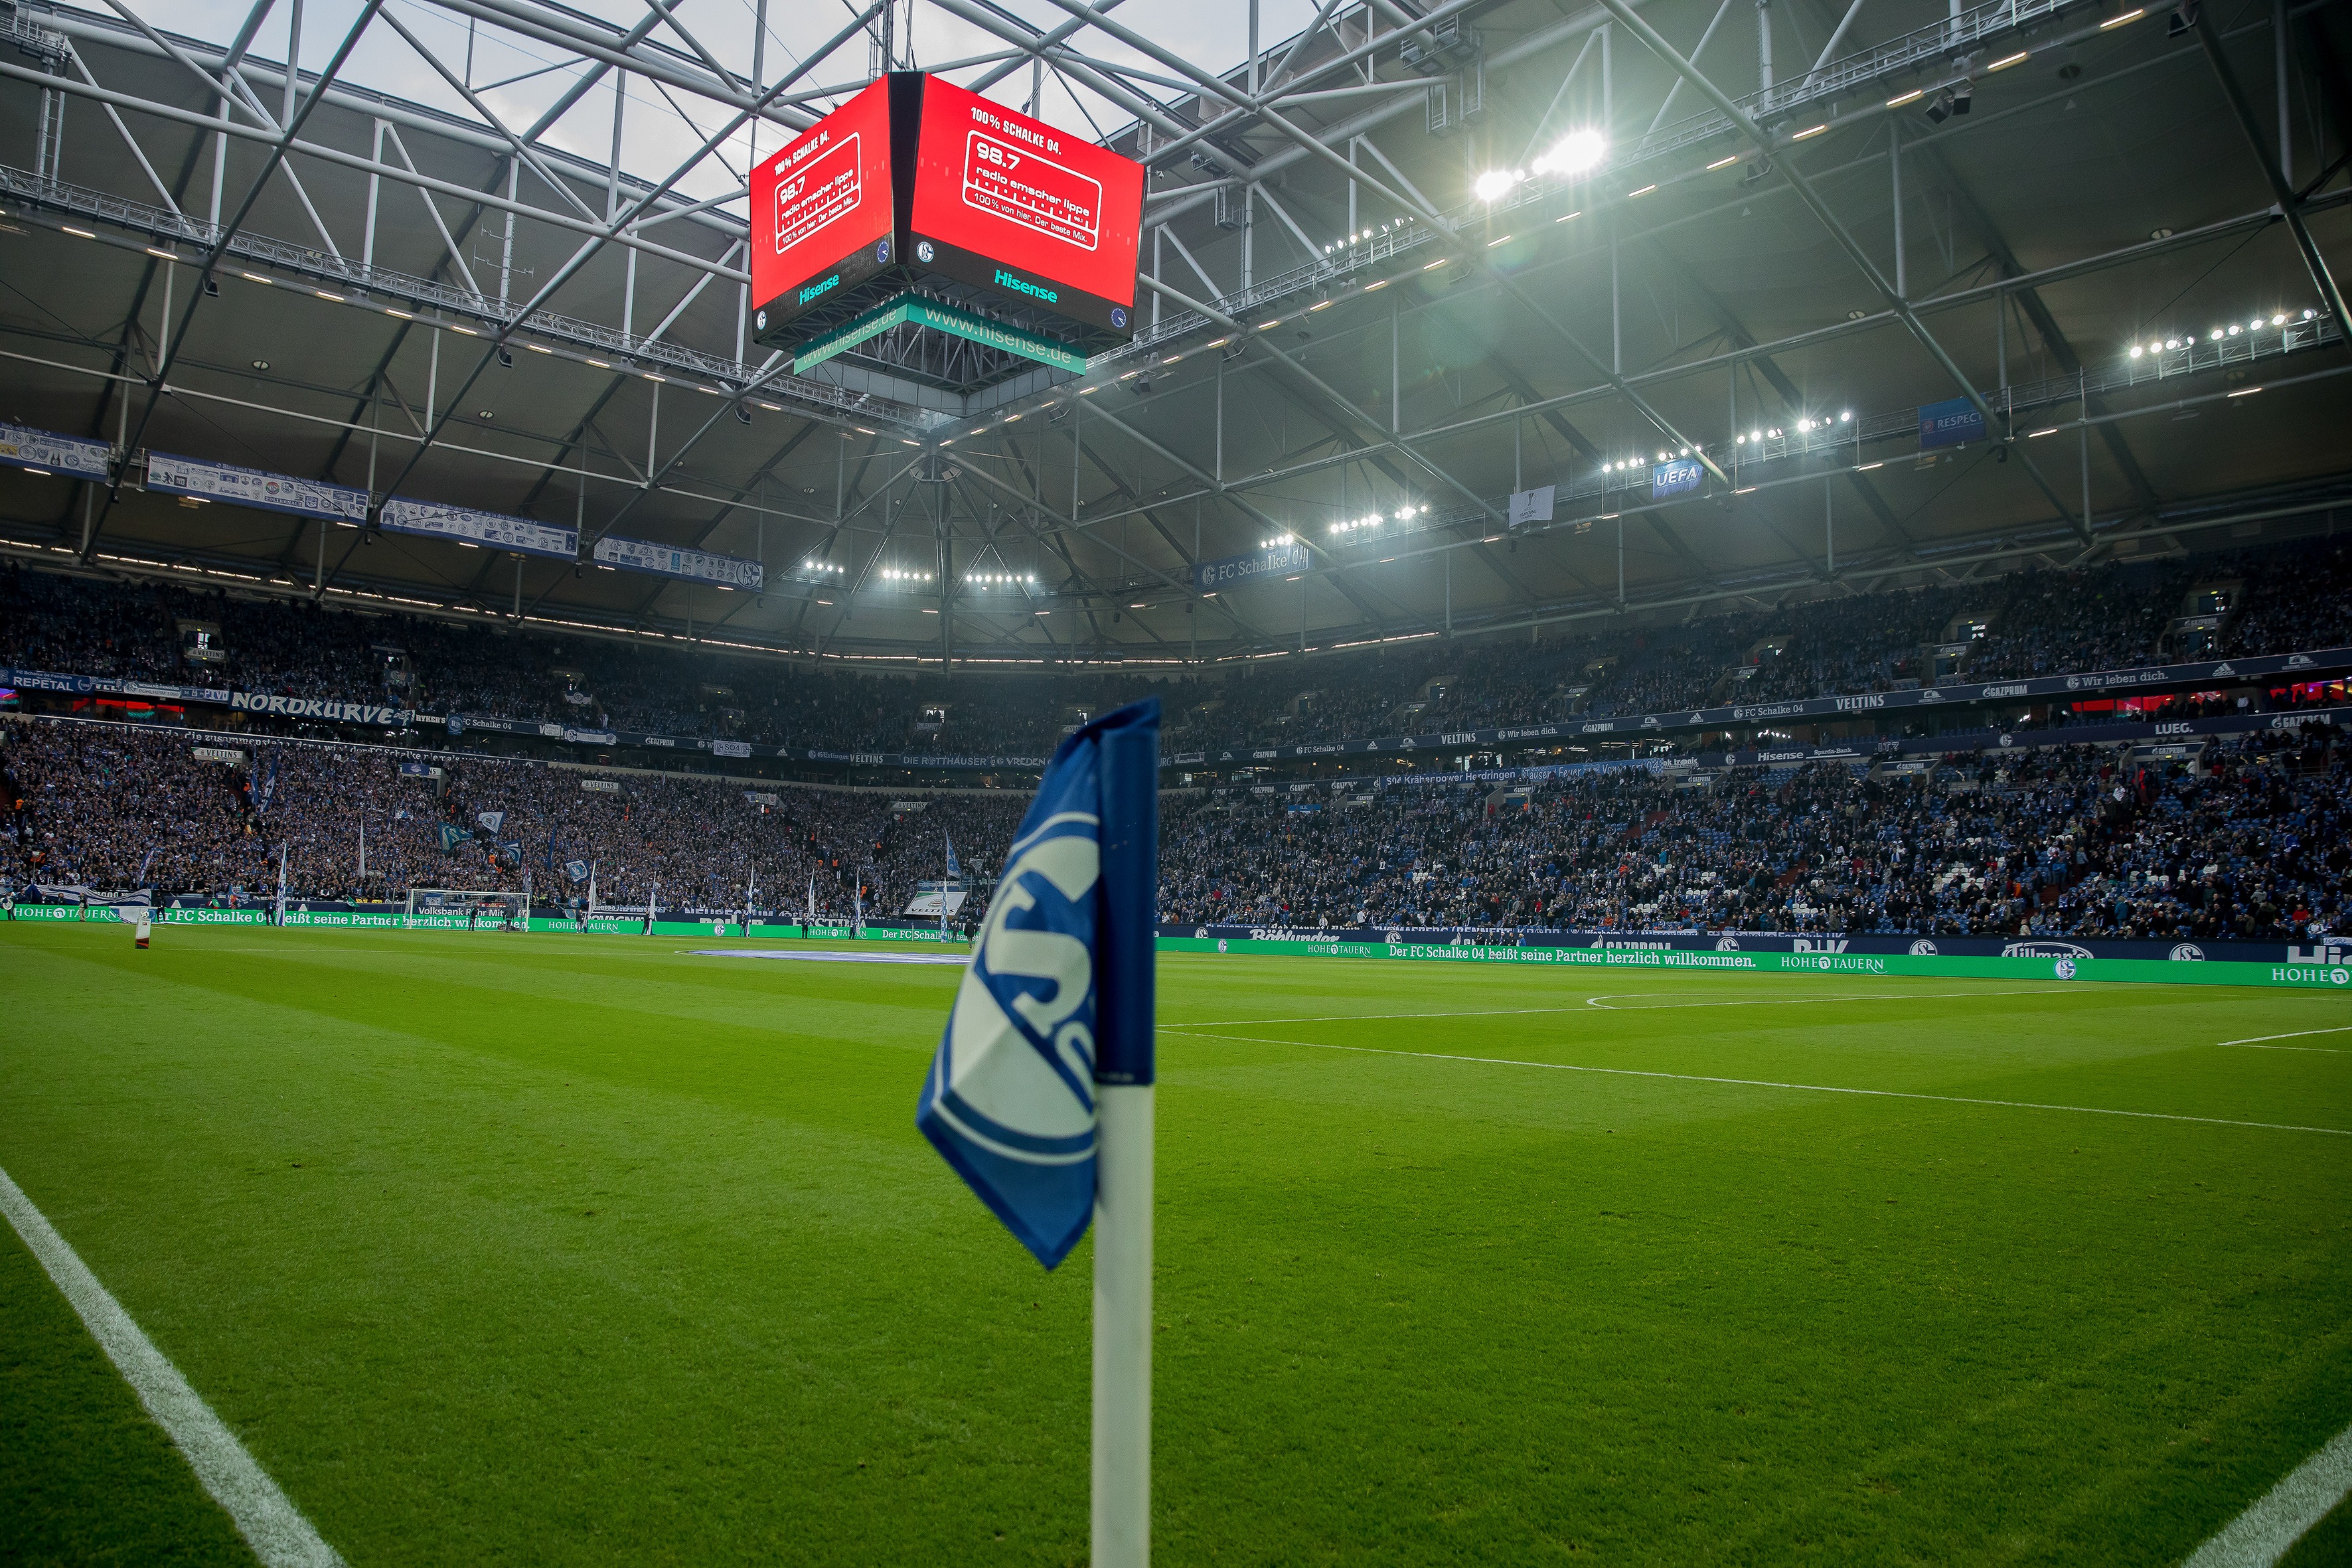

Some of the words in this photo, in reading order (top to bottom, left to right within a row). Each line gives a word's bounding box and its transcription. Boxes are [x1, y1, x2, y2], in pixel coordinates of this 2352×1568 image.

[971, 106, 1000, 130] 100%
[1003, 120, 1044, 148] SCHALKE
[1047, 139, 1062, 155] 04.
[774, 155, 792, 177] 100%
[792, 137, 819, 165] SCHALKE
[819, 129, 830, 146] 04.
[977, 141, 1020, 171] 98.7
[779, 175, 806, 205] 98.7
[781, 203, 801, 221] radio
[801, 181, 834, 208] emscher
[834, 168, 854, 187] lippe
[976, 167, 1008, 185] radio
[1010, 179, 1061, 205] emscher
[1063, 198, 1090, 217] lippe
[974, 193, 999, 209] 100%
[1000, 204, 1014, 215] von
[1016, 207, 1032, 222] hier.
[1034, 215, 1049, 228] Der
[1050, 221, 1071, 236] beste
[1072, 229, 1087, 243] Mix.
[782, 230, 797, 245] 100%
[818, 212, 827, 224] Der
[799, 274, 840, 305] Hisense
[994, 269, 1058, 303] Hisense
[803, 307, 896, 364] www.hisense.de
[925, 307, 1072, 364] www.hisense.de
[1937, 412, 1982, 428] RESPECT
[1656, 467, 1697, 487] UEFA
[1219, 565, 1235, 581] FC
[1238, 554, 1287, 577] Schalke
[13, 676, 74, 692] REPETAL
[2082, 675, 2103, 686] Wir
[2106, 673, 2137, 685] leben
[2140, 671, 2168, 683] dich.
[1990, 685, 2027, 697] GAZPROM
[232, 692, 394, 724] NORDKURVE
[1745, 708, 1756, 716] FC
[1758, 706, 1791, 716] Schalke
[1792, 704, 1803, 713] 04
[1836, 695, 1885, 710] VELTINS
[473, 720, 501, 729] Schalke
[1587, 723, 1614, 733] GAZPROM
[2155, 722, 2194, 735] LUEG.
[651, 738, 674, 746] GAZPROM
[1441, 733, 1476, 744] VELTINS
[206, 749, 237, 758] VELTINS
[850, 754, 884, 763] VELTINS
[1758, 751, 1804, 761] Hisense
[1814, 747, 1852, 755] Sparda-Bank
[903, 756, 919, 765] DIE
[1006, 757, 1046, 766] VREDEN
[1646, 760, 1659, 772] 04
[1466, 771, 1516, 781] Herdringen
[15, 907, 52, 917] HOHE
[418, 906, 463, 915] Volksbank
[466, 907, 487, 916] Rhr
[175, 910, 195, 921] FC
[198, 909, 253, 922] Schalke
[285, 913, 311, 924] eißt
[313, 913, 349, 924] seine
[351, 914, 400, 927] Partner
[402, 915, 451, 929] herzlich
[548, 921, 576, 930] HOHE
[882, 929, 898, 939] Der
[900, 930, 912, 939] FC
[914, 931, 941, 940] Schalk
[1308, 944, 1331, 953] HOHE
[1337, 945, 1372, 959] TAUERN
[1389, 945, 1407, 957] Der
[1410, 946, 1424, 957] FC
[1427, 946, 1468, 959] Schalke
[1472, 947, 1484, 959] 04
[1488, 947, 1518, 961] heißt
[1521, 949, 1553, 961] seine
[1555, 949, 1603, 963] Partner
[1606, 951, 1660, 965] herzlich
[1664, 952, 1757, 967] willkommen.
[1782, 957, 1818, 968] HOHE
[1832, 958, 1888, 974] TAUERN
[2272, 969, 2329, 982] HOHE
